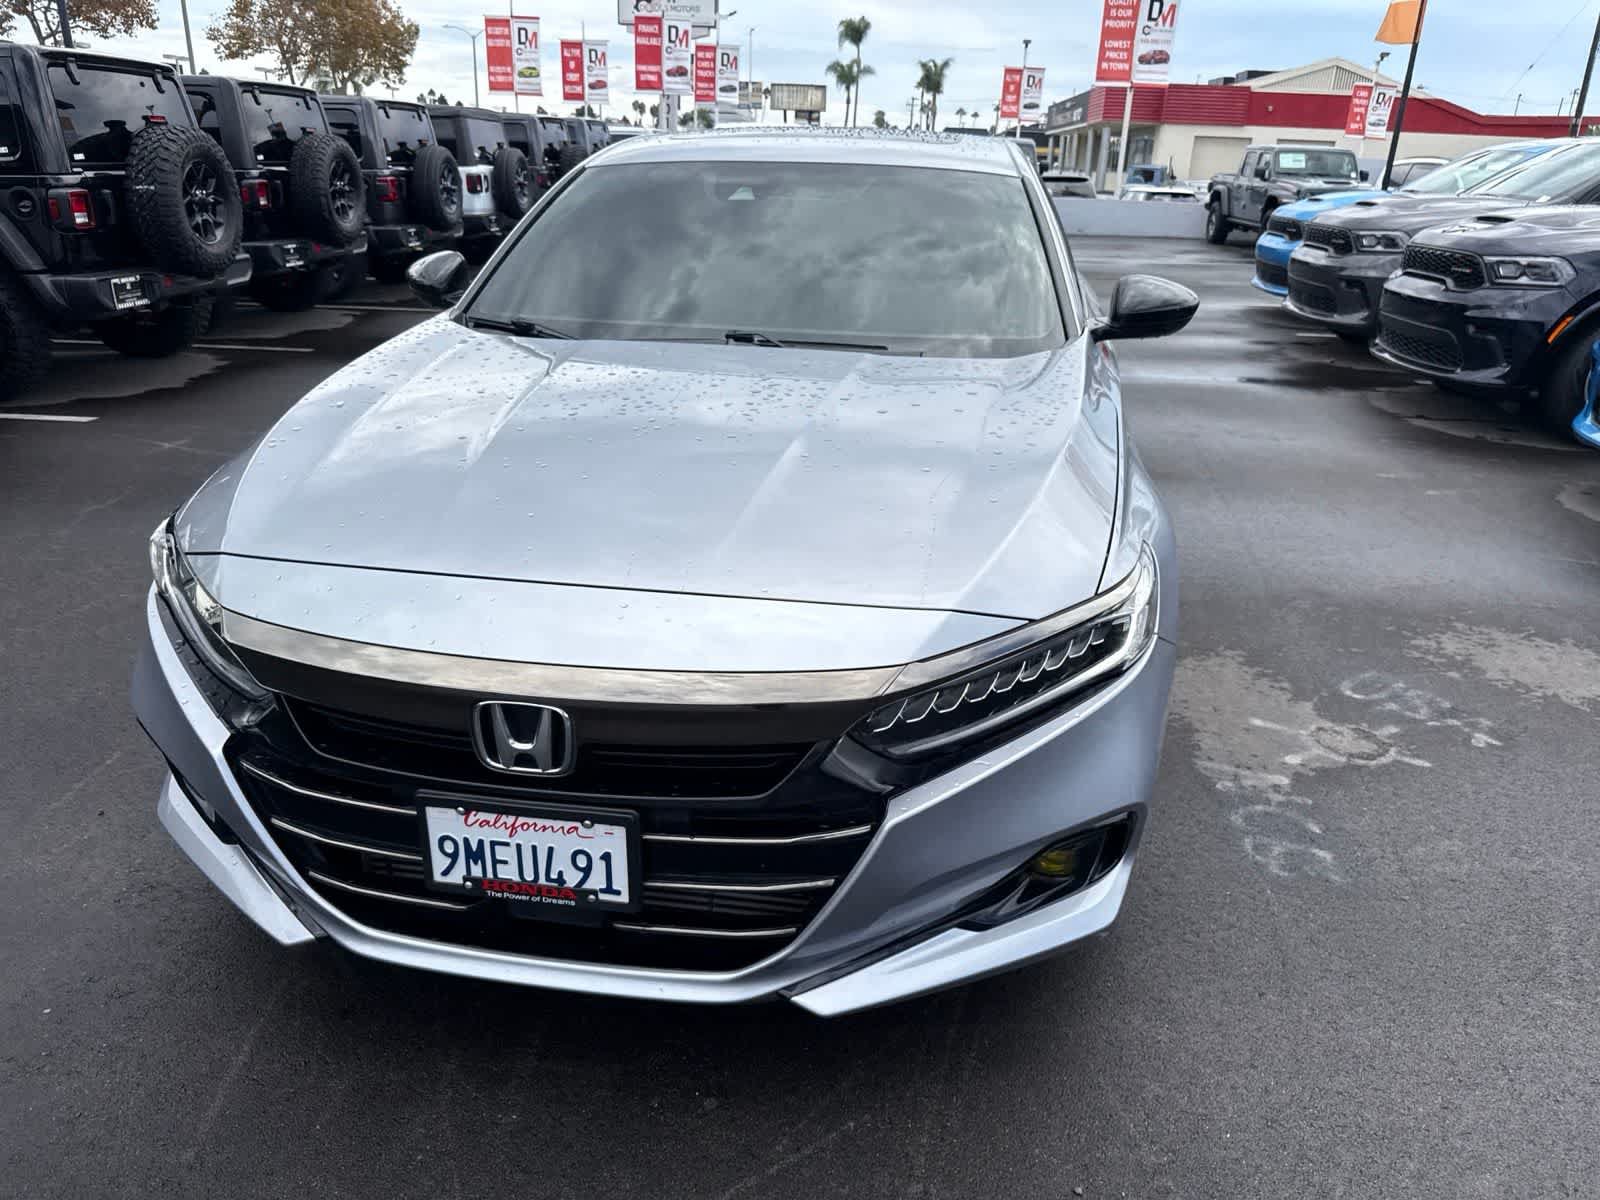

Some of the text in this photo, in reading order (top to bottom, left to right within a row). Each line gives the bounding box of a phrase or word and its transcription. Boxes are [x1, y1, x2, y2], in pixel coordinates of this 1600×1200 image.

[1117, 9, 1133, 17] OUR
[1104, 19, 1136, 28] PRIORITY
[1104, 40, 1131, 48] LOWEST
[1105, 51, 1128, 59] PRICES
[1109, 62, 1129, 71] TOWN
[463, 809, 595, 839] California
[437, 834, 622, 896] 9MEU491
[481, 879, 577, 901] HONDA
[487, 890, 502, 898] The
[503, 892, 530, 901] Power
[542, 896, 576, 906] Dreams
